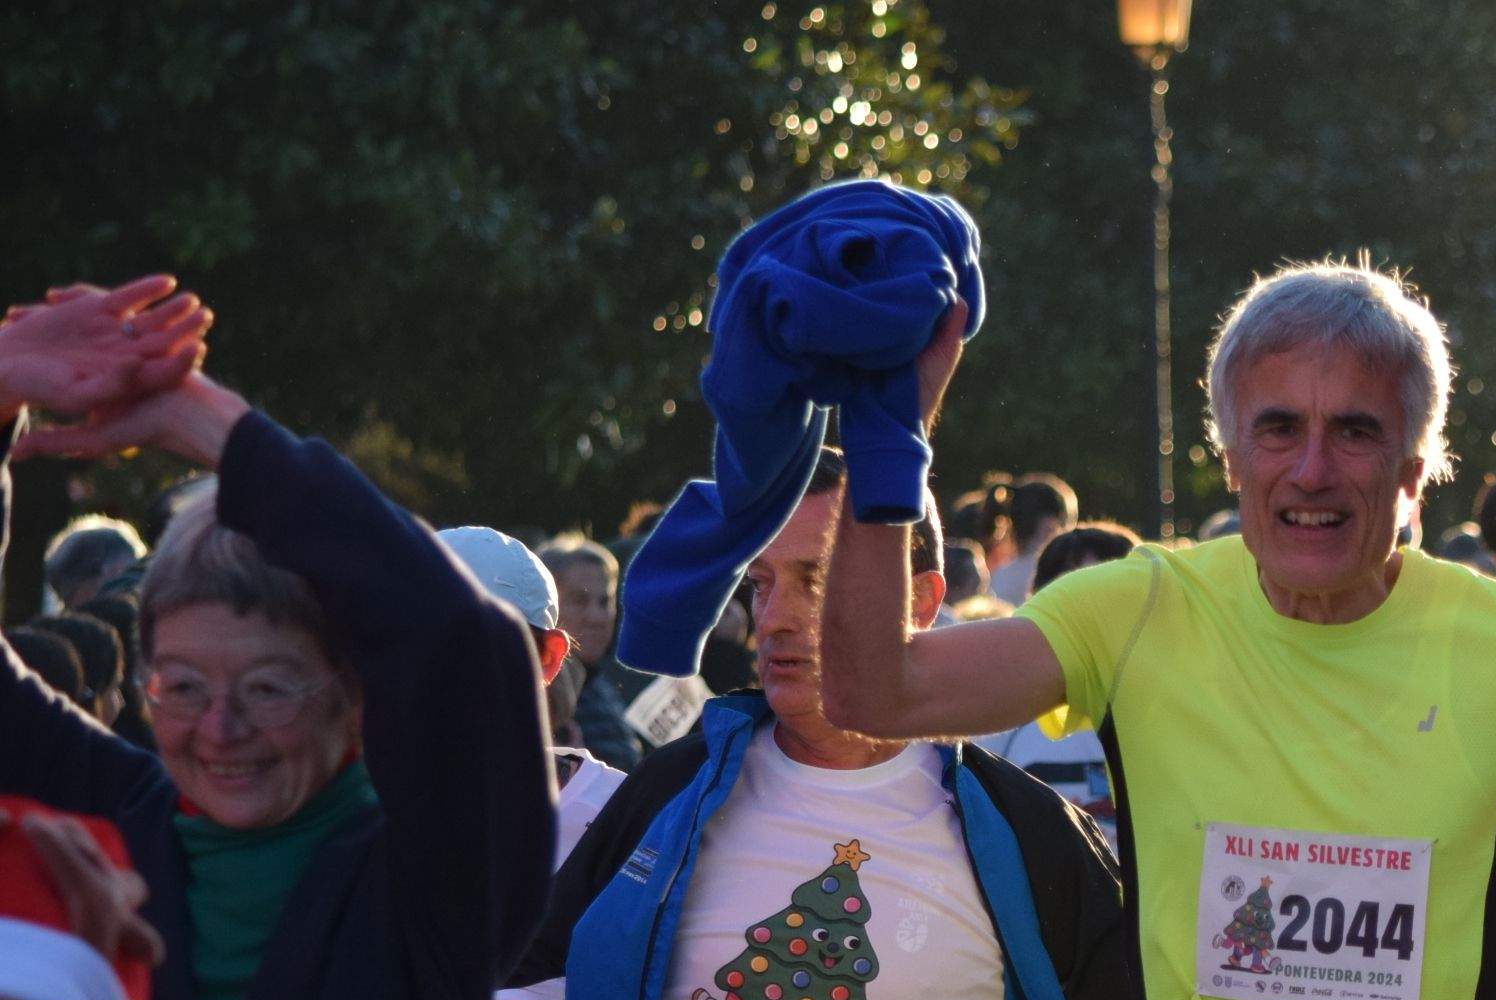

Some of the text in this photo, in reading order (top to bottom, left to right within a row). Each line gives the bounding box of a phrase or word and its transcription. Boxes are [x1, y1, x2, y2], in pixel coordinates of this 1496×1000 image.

[1225, 835, 1412, 870] XLI SAN SILVESTRE
[1276, 894, 1415, 961] 2044
[1274, 963, 1403, 987] PONTEVEDRA 2024
